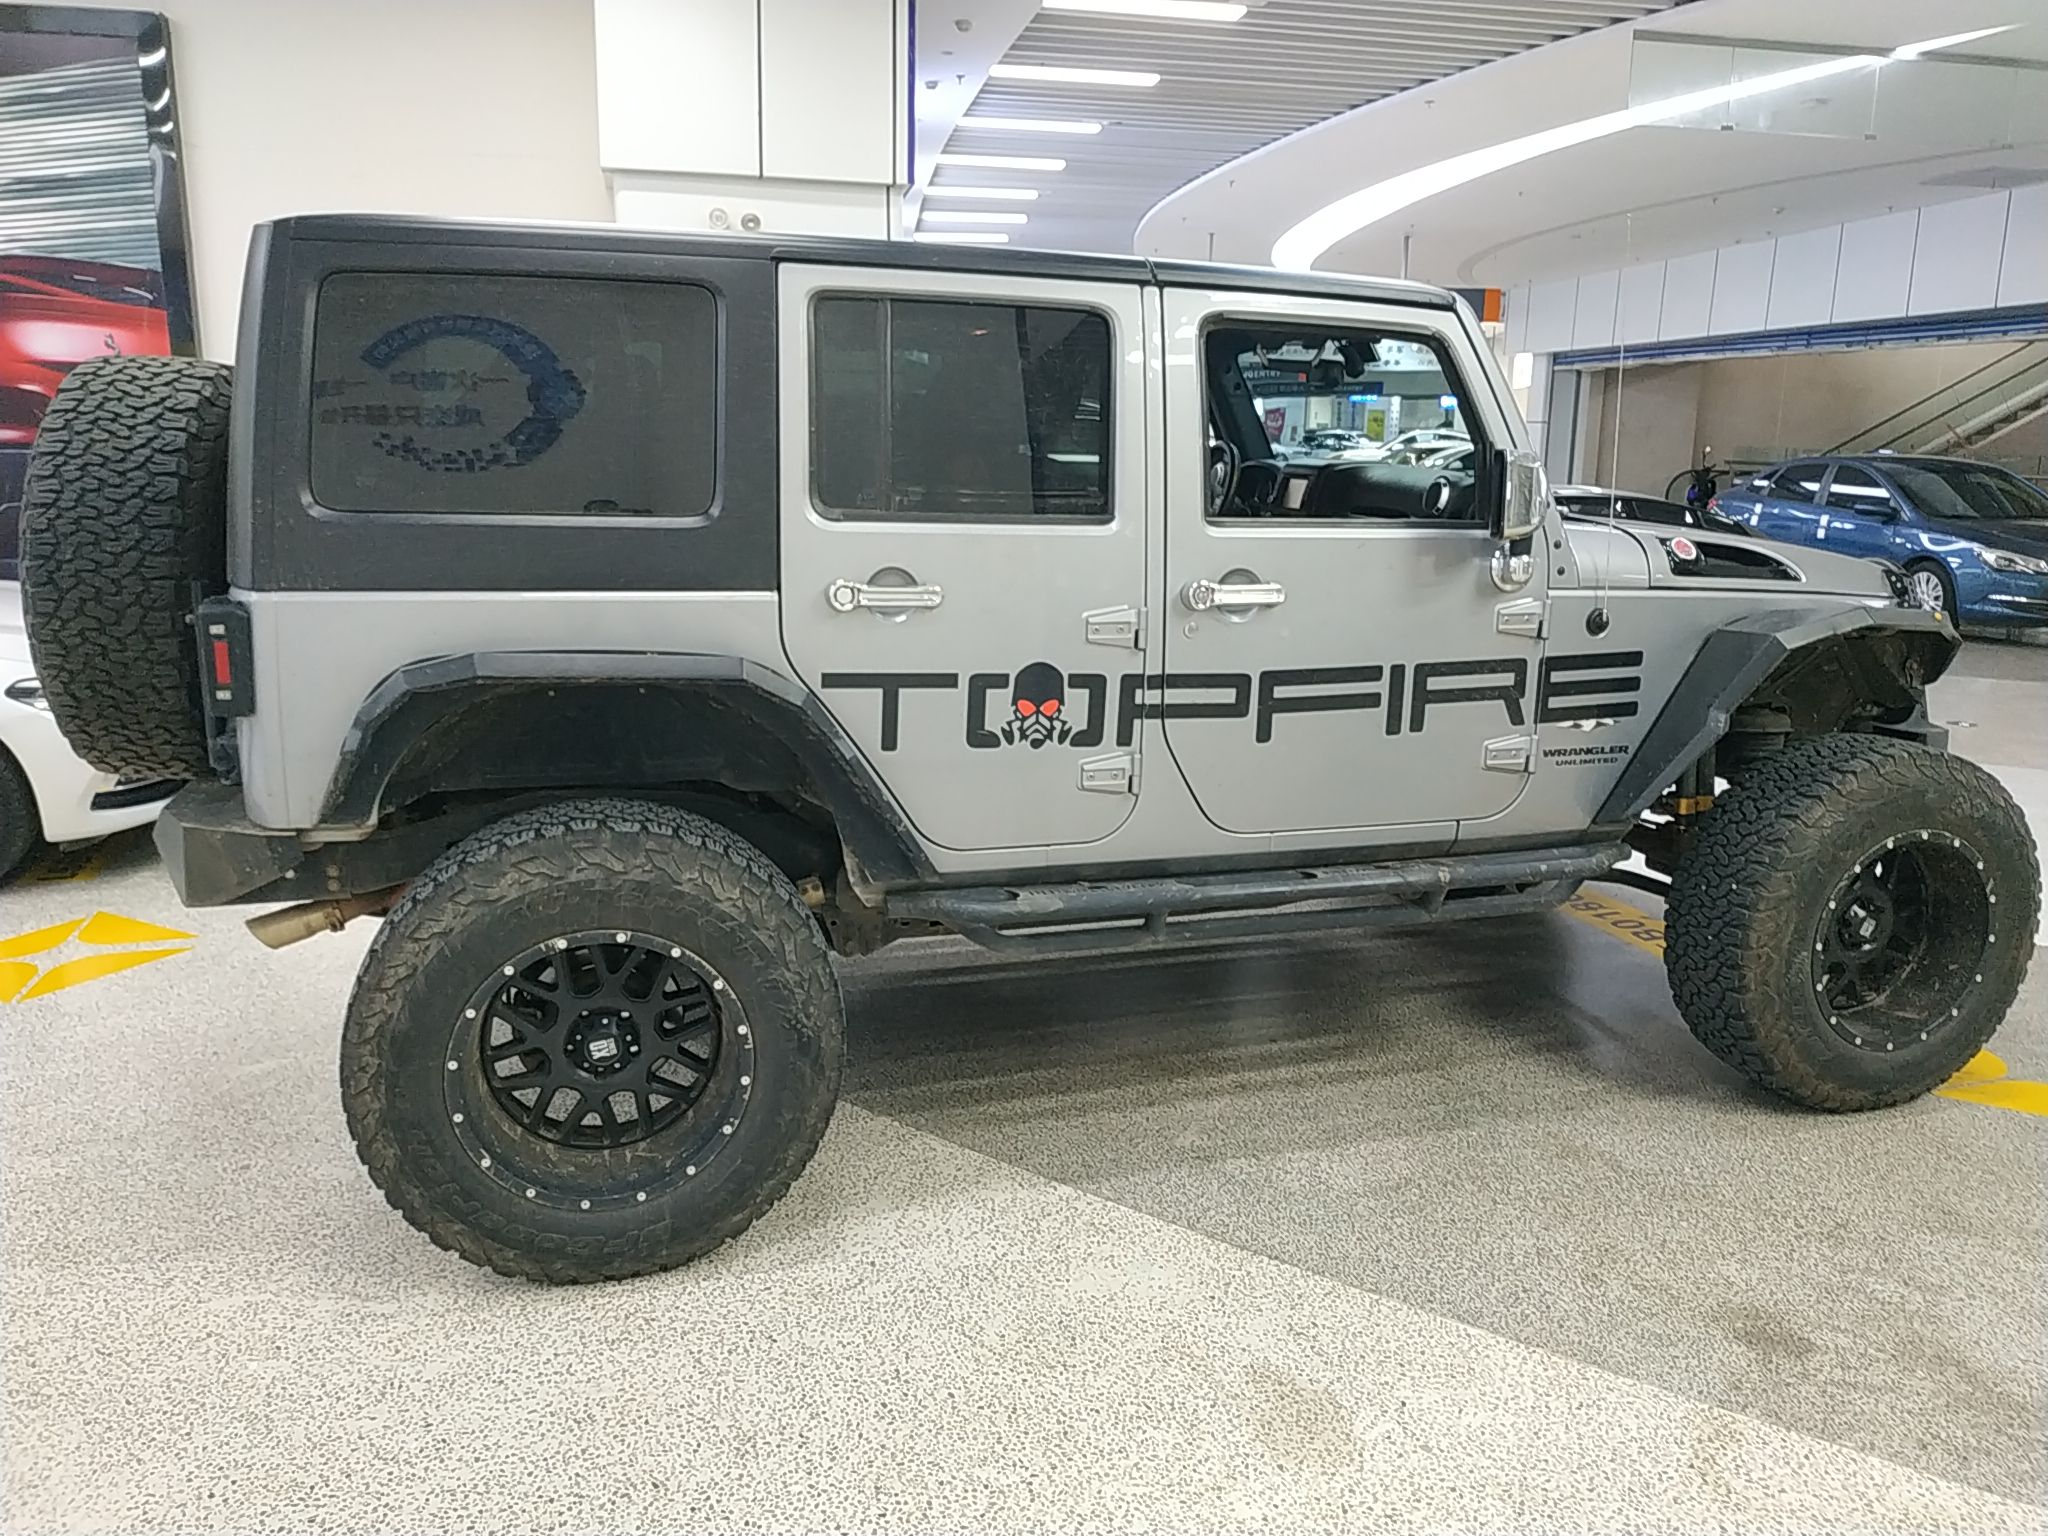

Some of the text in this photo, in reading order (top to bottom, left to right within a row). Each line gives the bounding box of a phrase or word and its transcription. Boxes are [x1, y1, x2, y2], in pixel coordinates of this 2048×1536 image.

[821, 651, 1644, 752] TOPFIRE
[1542, 745, 1630, 758] WRANGLER
[1555, 757, 1618, 767] UNLIMITED
